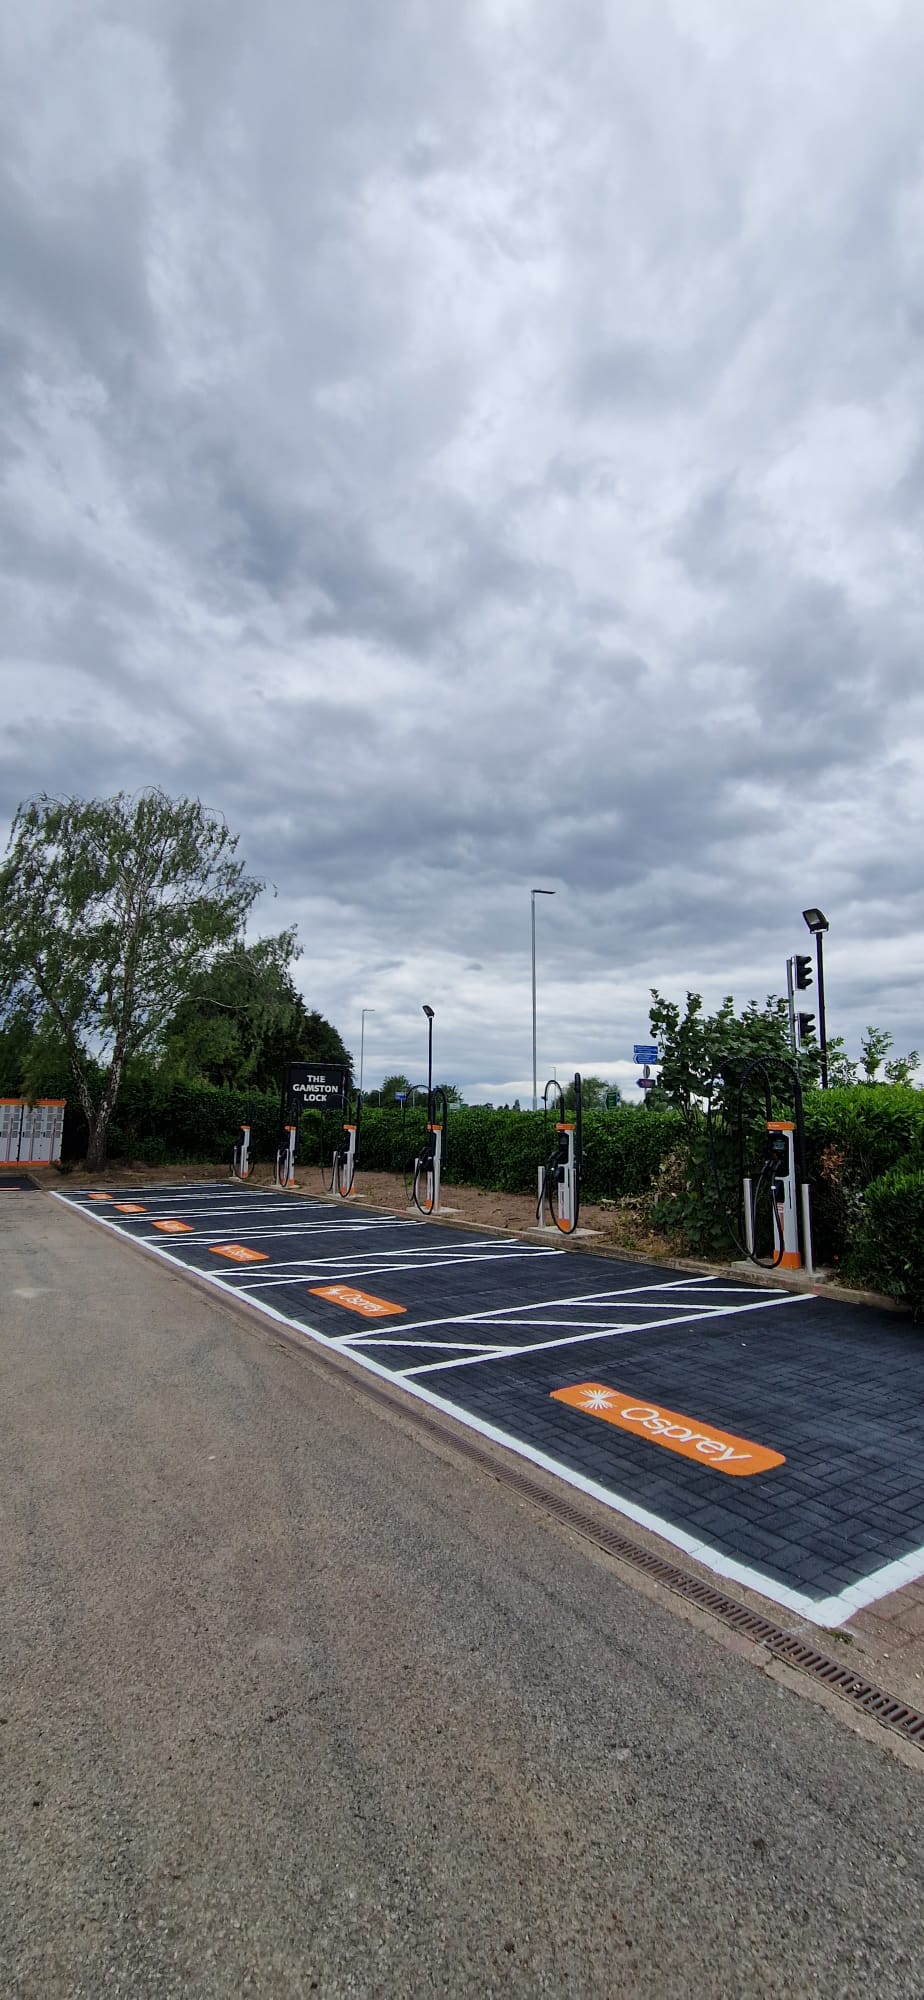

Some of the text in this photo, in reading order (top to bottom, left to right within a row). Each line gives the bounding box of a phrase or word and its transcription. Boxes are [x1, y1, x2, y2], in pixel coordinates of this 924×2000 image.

[306, 1075, 326, 1083] THE
[292, 1084, 339, 1093] GAMSTON
[303, 1094, 328, 1102] LOCK
[620, 1406, 753, 1463] Osprey
